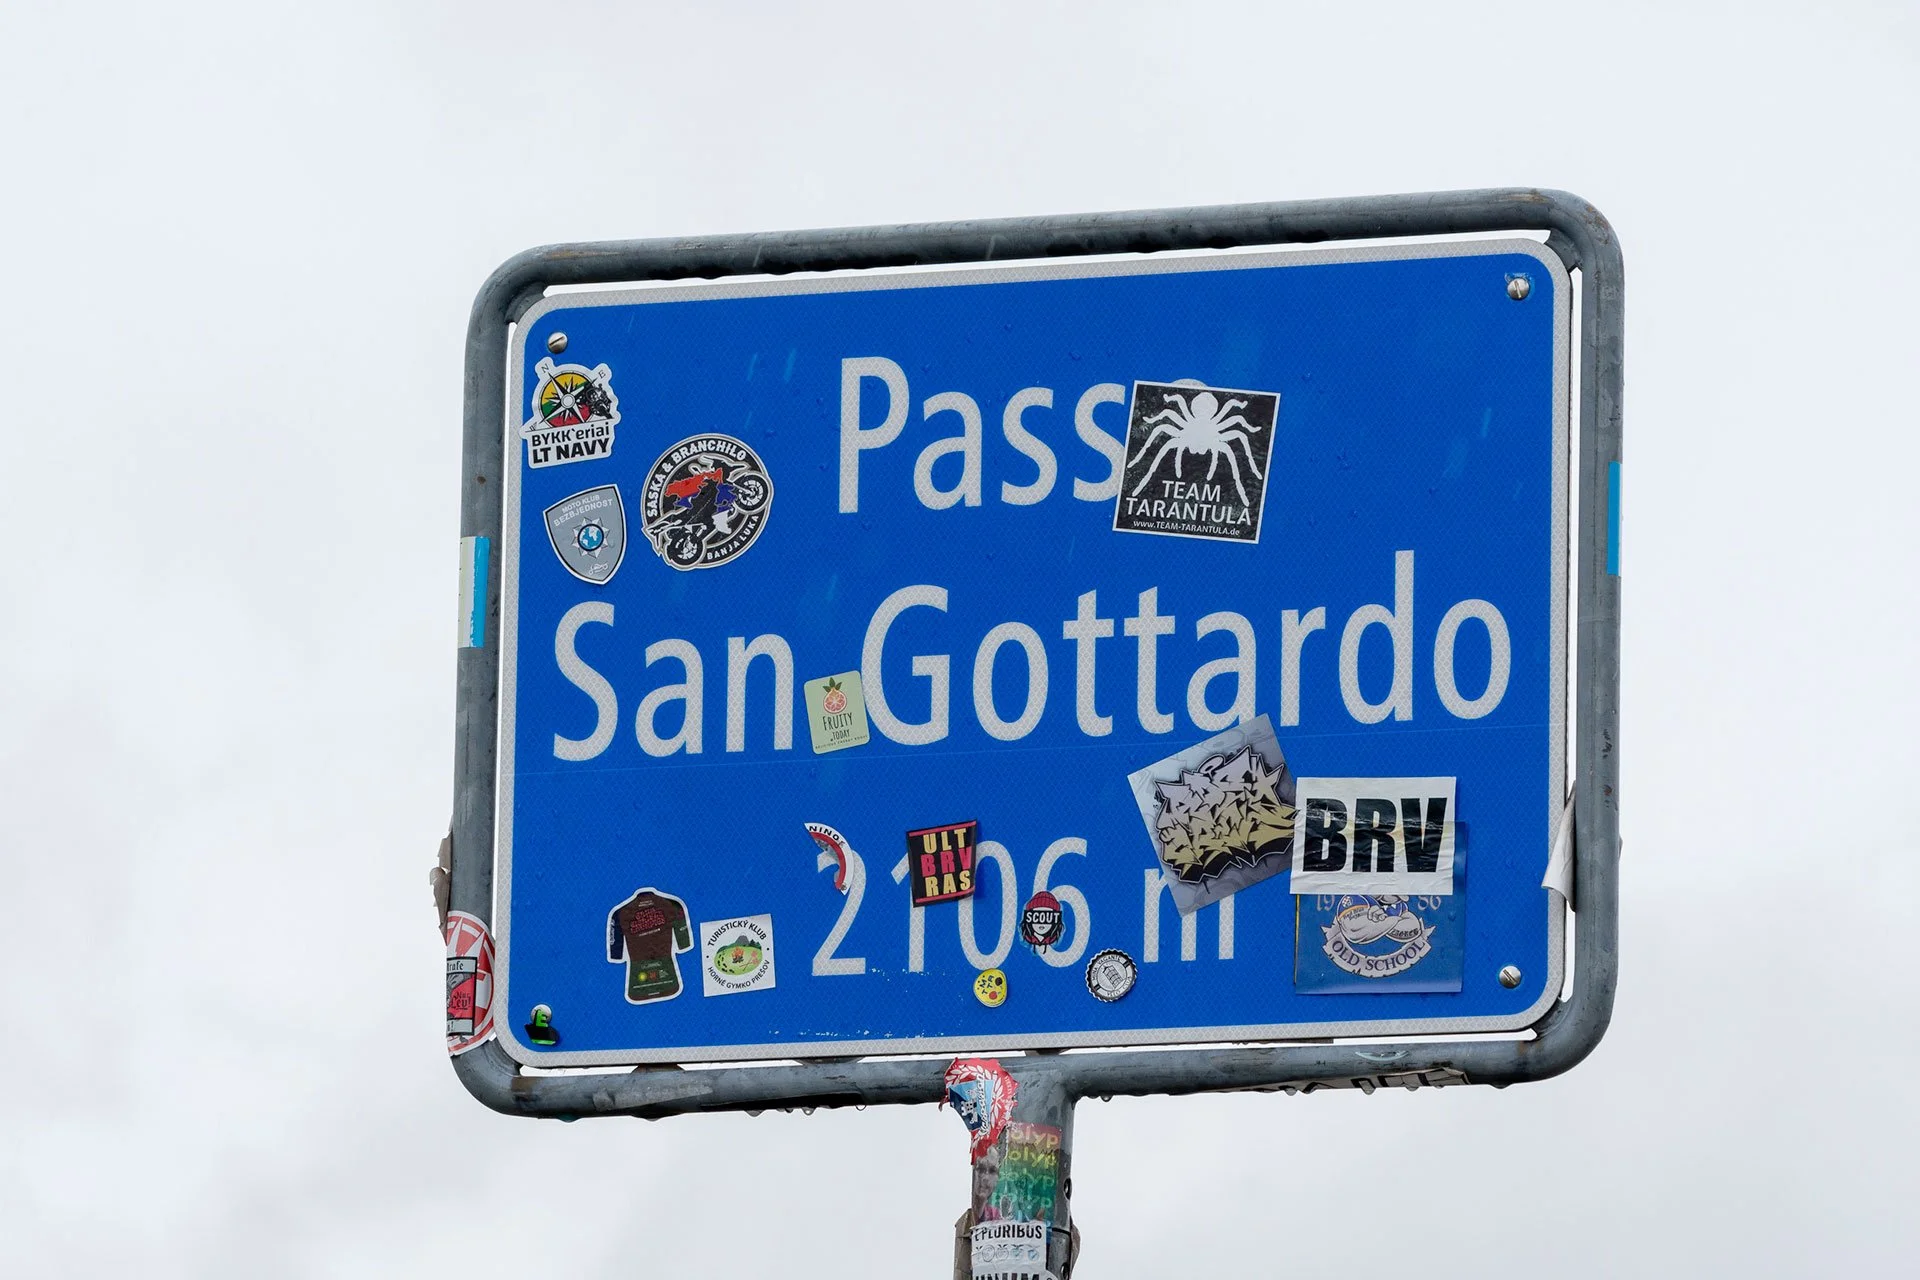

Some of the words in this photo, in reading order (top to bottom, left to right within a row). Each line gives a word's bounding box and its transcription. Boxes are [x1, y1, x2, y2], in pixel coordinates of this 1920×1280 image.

[838, 356, 1208, 514] Pass
[532, 447, 552, 465] LT
[555, 438, 611, 460] NAVY
[646, 473, 667, 517] SASKA
[661, 462, 674, 473] &
[671, 439, 747, 462] BRANCHILO
[1161, 480, 1222, 503] TEAM
[553, 498, 614, 527] BEZBJEDNOST
[561, 500, 582, 514] MOTO
[582, 494, 601, 505] KLUB
[1125, 497, 1252, 526] TARANTULA
[706, 540, 740, 560] BANJA
[739, 514, 760, 541] LUKA
[1132, 520, 1241, 536] www.TEAM-TARANTULA.de
[552, 601, 795, 762] San
[860, 551, 1512, 747] Gottardo
[822, 712, 853, 731] FRUITY
[808, 825, 846, 847] NINO
[922, 828, 967, 854] ULT
[1302, 797, 1448, 874] BRV
[920, 845, 973, 878] BRV
[924, 870, 971, 898] RAS
[811, 836, 1092, 977] 2106
[1025, 911, 1060, 924] SCOUT
[748, 922, 767, 941] KLUB
[1331, 940, 1360, 966] OLD
[1364, 940, 1426, 971] SCHOOL
[726, 979, 751, 989] GYMKO
[1010, 1126, 1059, 1149] olyp
[1007, 1147, 1058, 1170] olyp
